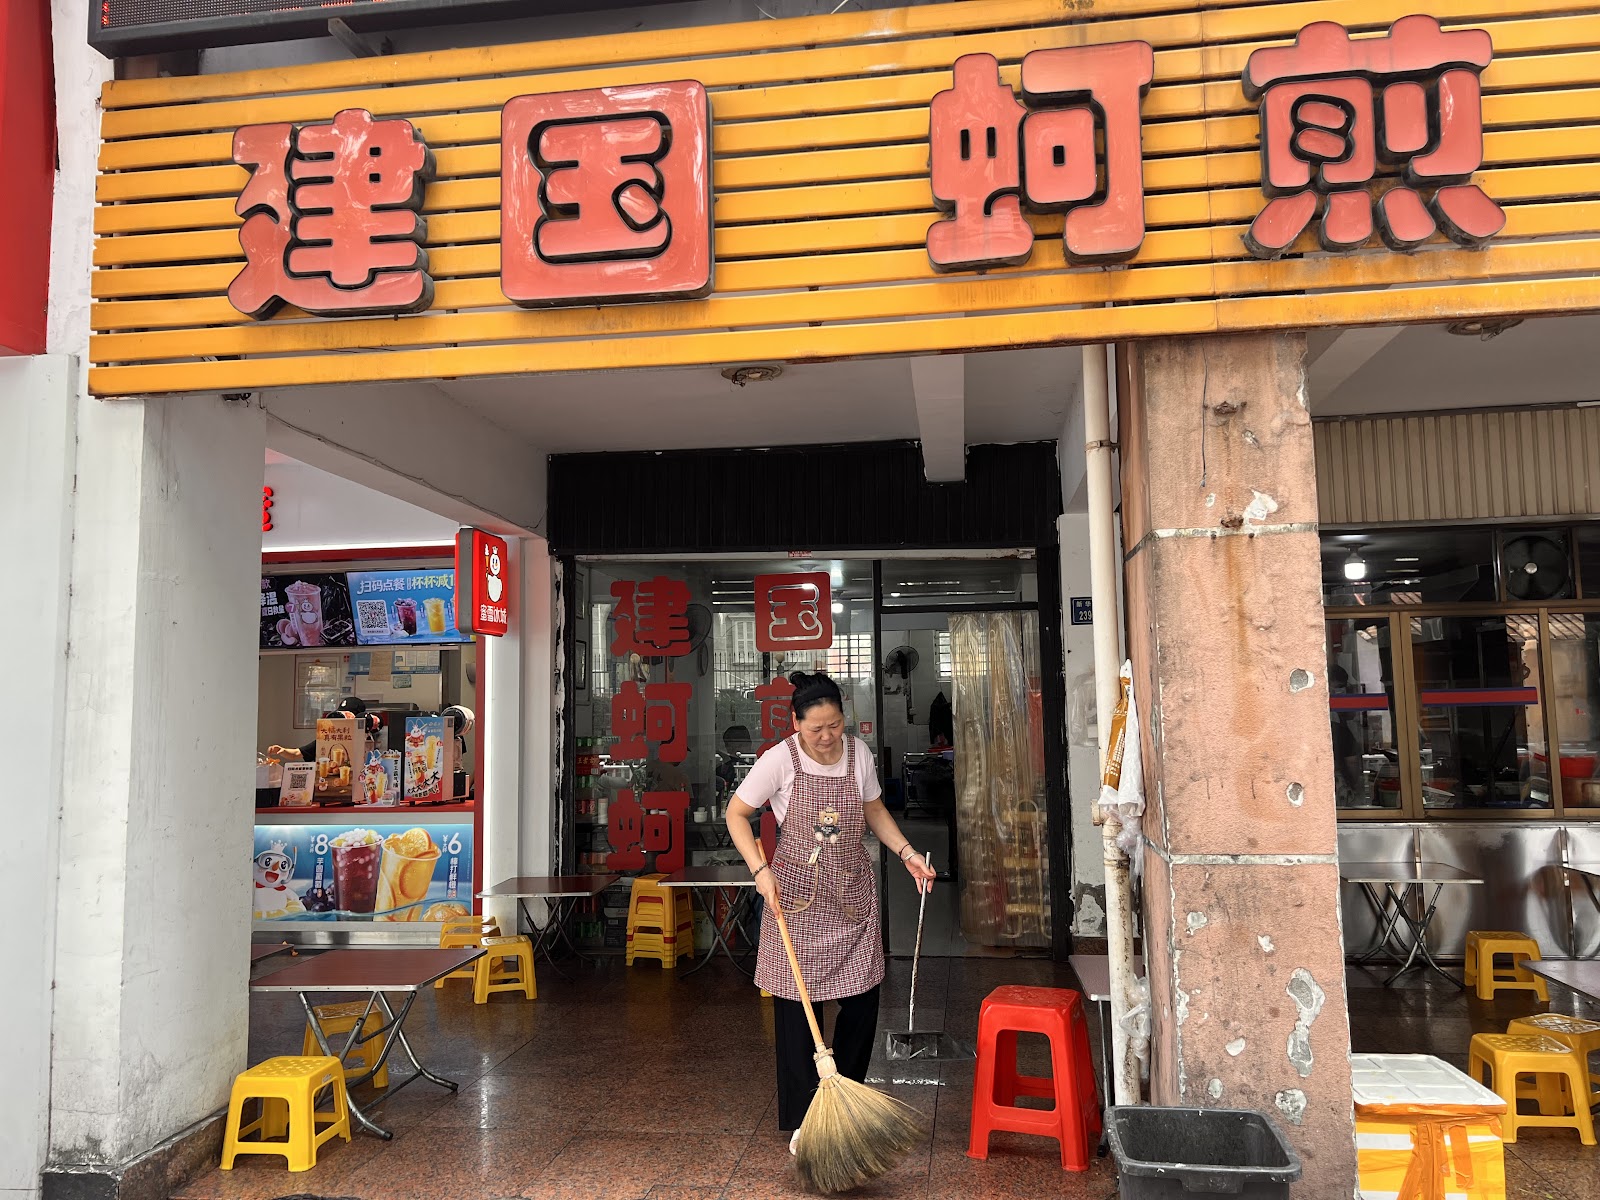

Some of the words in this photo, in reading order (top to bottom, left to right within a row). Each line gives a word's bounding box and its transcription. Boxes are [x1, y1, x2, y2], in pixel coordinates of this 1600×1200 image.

[357, 577, 405, 594] 扫码点餐
[480, 604, 507, 624] 蜜雪冰城
[1079, 611, 1092, 620] 239
